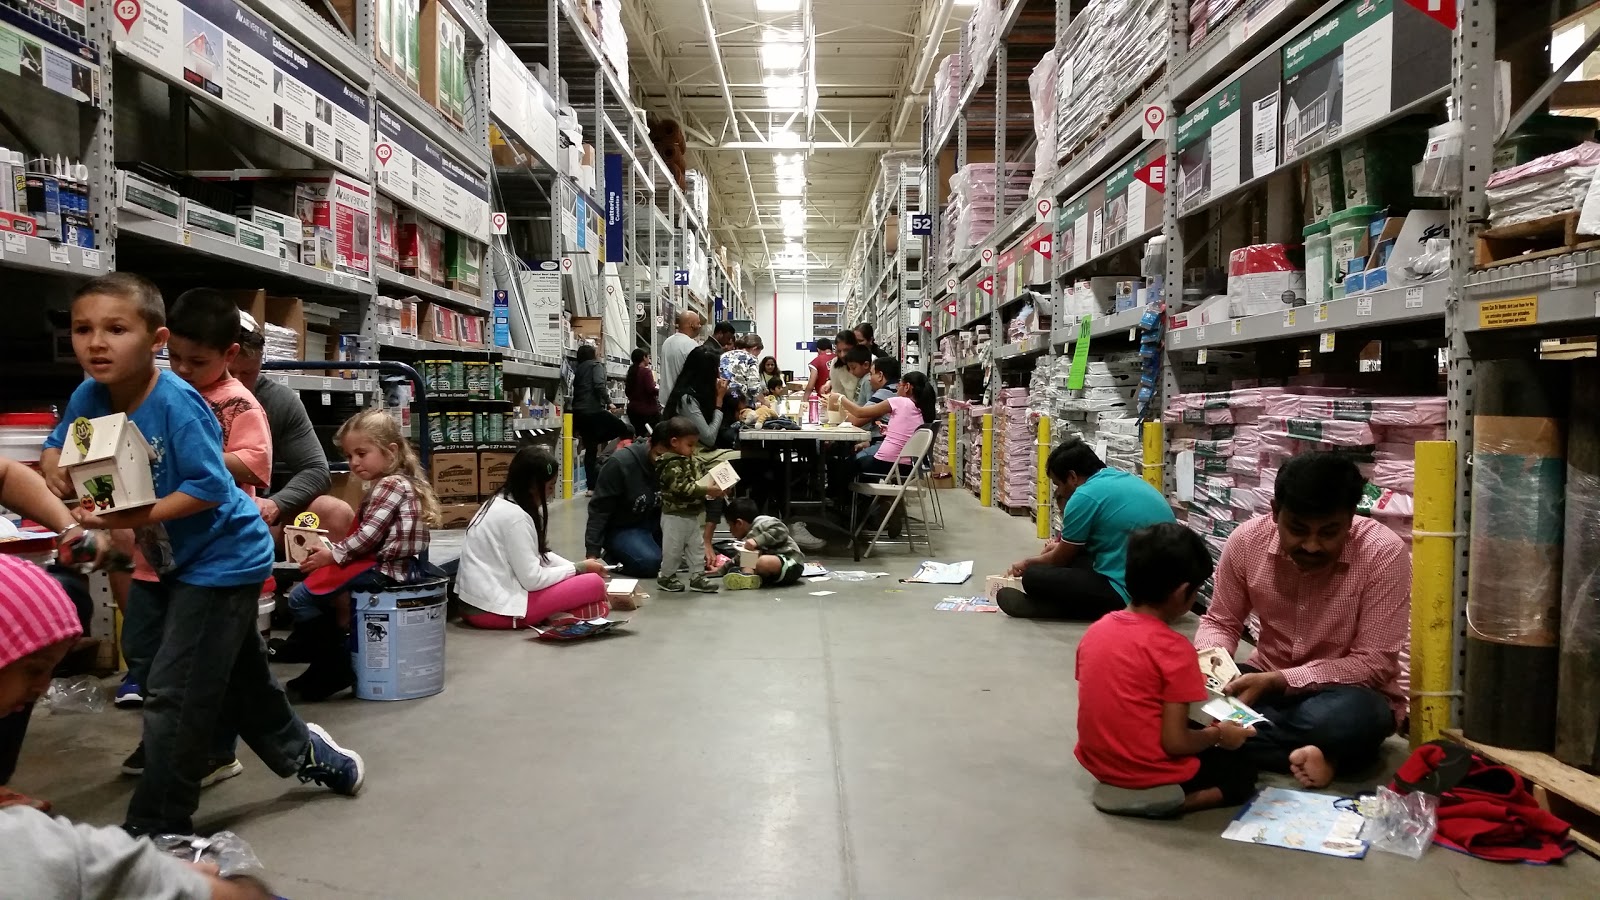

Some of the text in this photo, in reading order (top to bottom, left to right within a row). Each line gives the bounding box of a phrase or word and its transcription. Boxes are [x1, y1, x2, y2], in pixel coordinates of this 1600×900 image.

[120, 6, 134, 14] 12
[1286, 18, 1339, 58] Supreme Shingles
[273, 36, 293, 59] Exhaust
[294, 52, 308, 69] vents
[1178, 107, 1209, 134] Supreme Shingles
[1150, 166, 1163, 183] E
[912, 219, 931, 229] 52
[1040, 241, 1050, 253] D
[675, 273, 688, 281] 21
[984, 280, 992, 290] C
